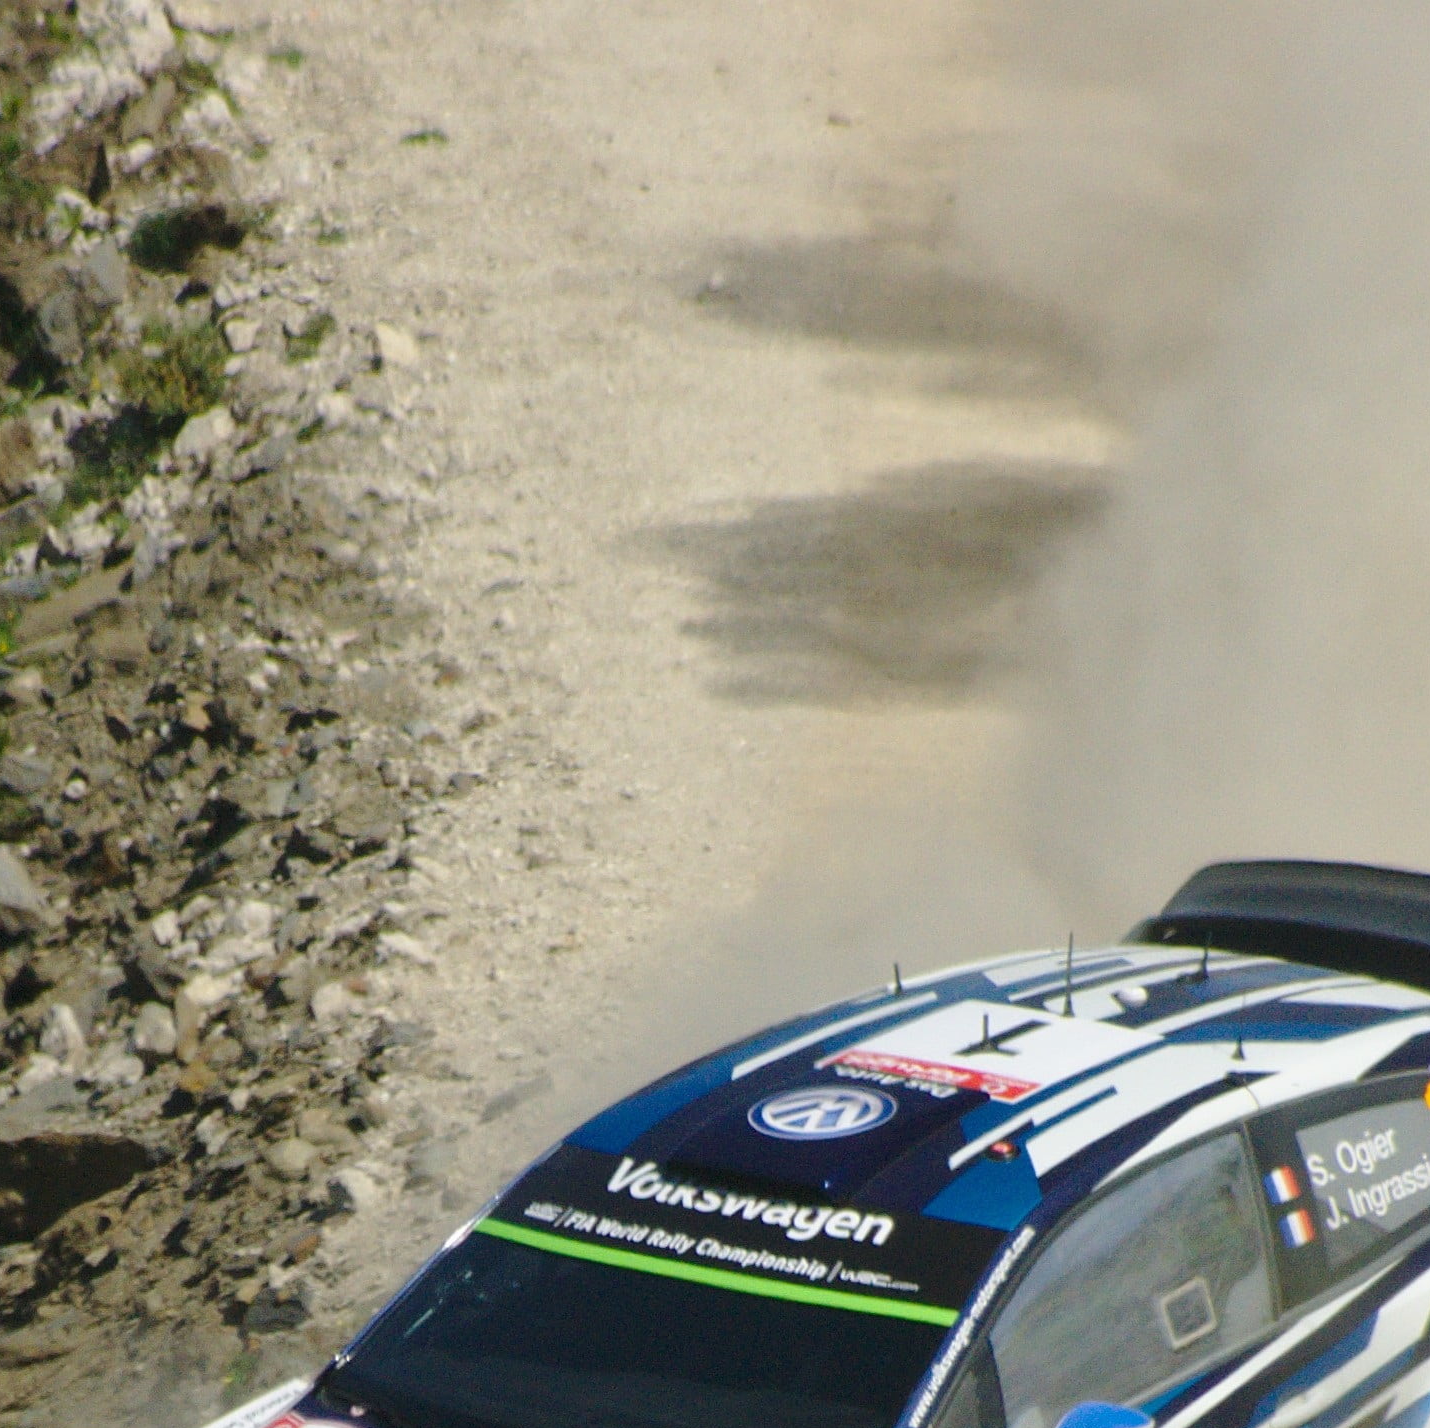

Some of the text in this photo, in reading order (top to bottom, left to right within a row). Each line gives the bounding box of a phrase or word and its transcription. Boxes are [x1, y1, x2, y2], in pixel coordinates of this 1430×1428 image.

[1307, 1127, 1398, 1187] S. Ogier
[606, 1156, 895, 1246] Volkswagen
[1326, 1196, 1350, 1231] J.
[596, 1217, 648, 1244] World
[648, 1228, 695, 1255] Rally
[695, 1237, 829, 1282] Championship
